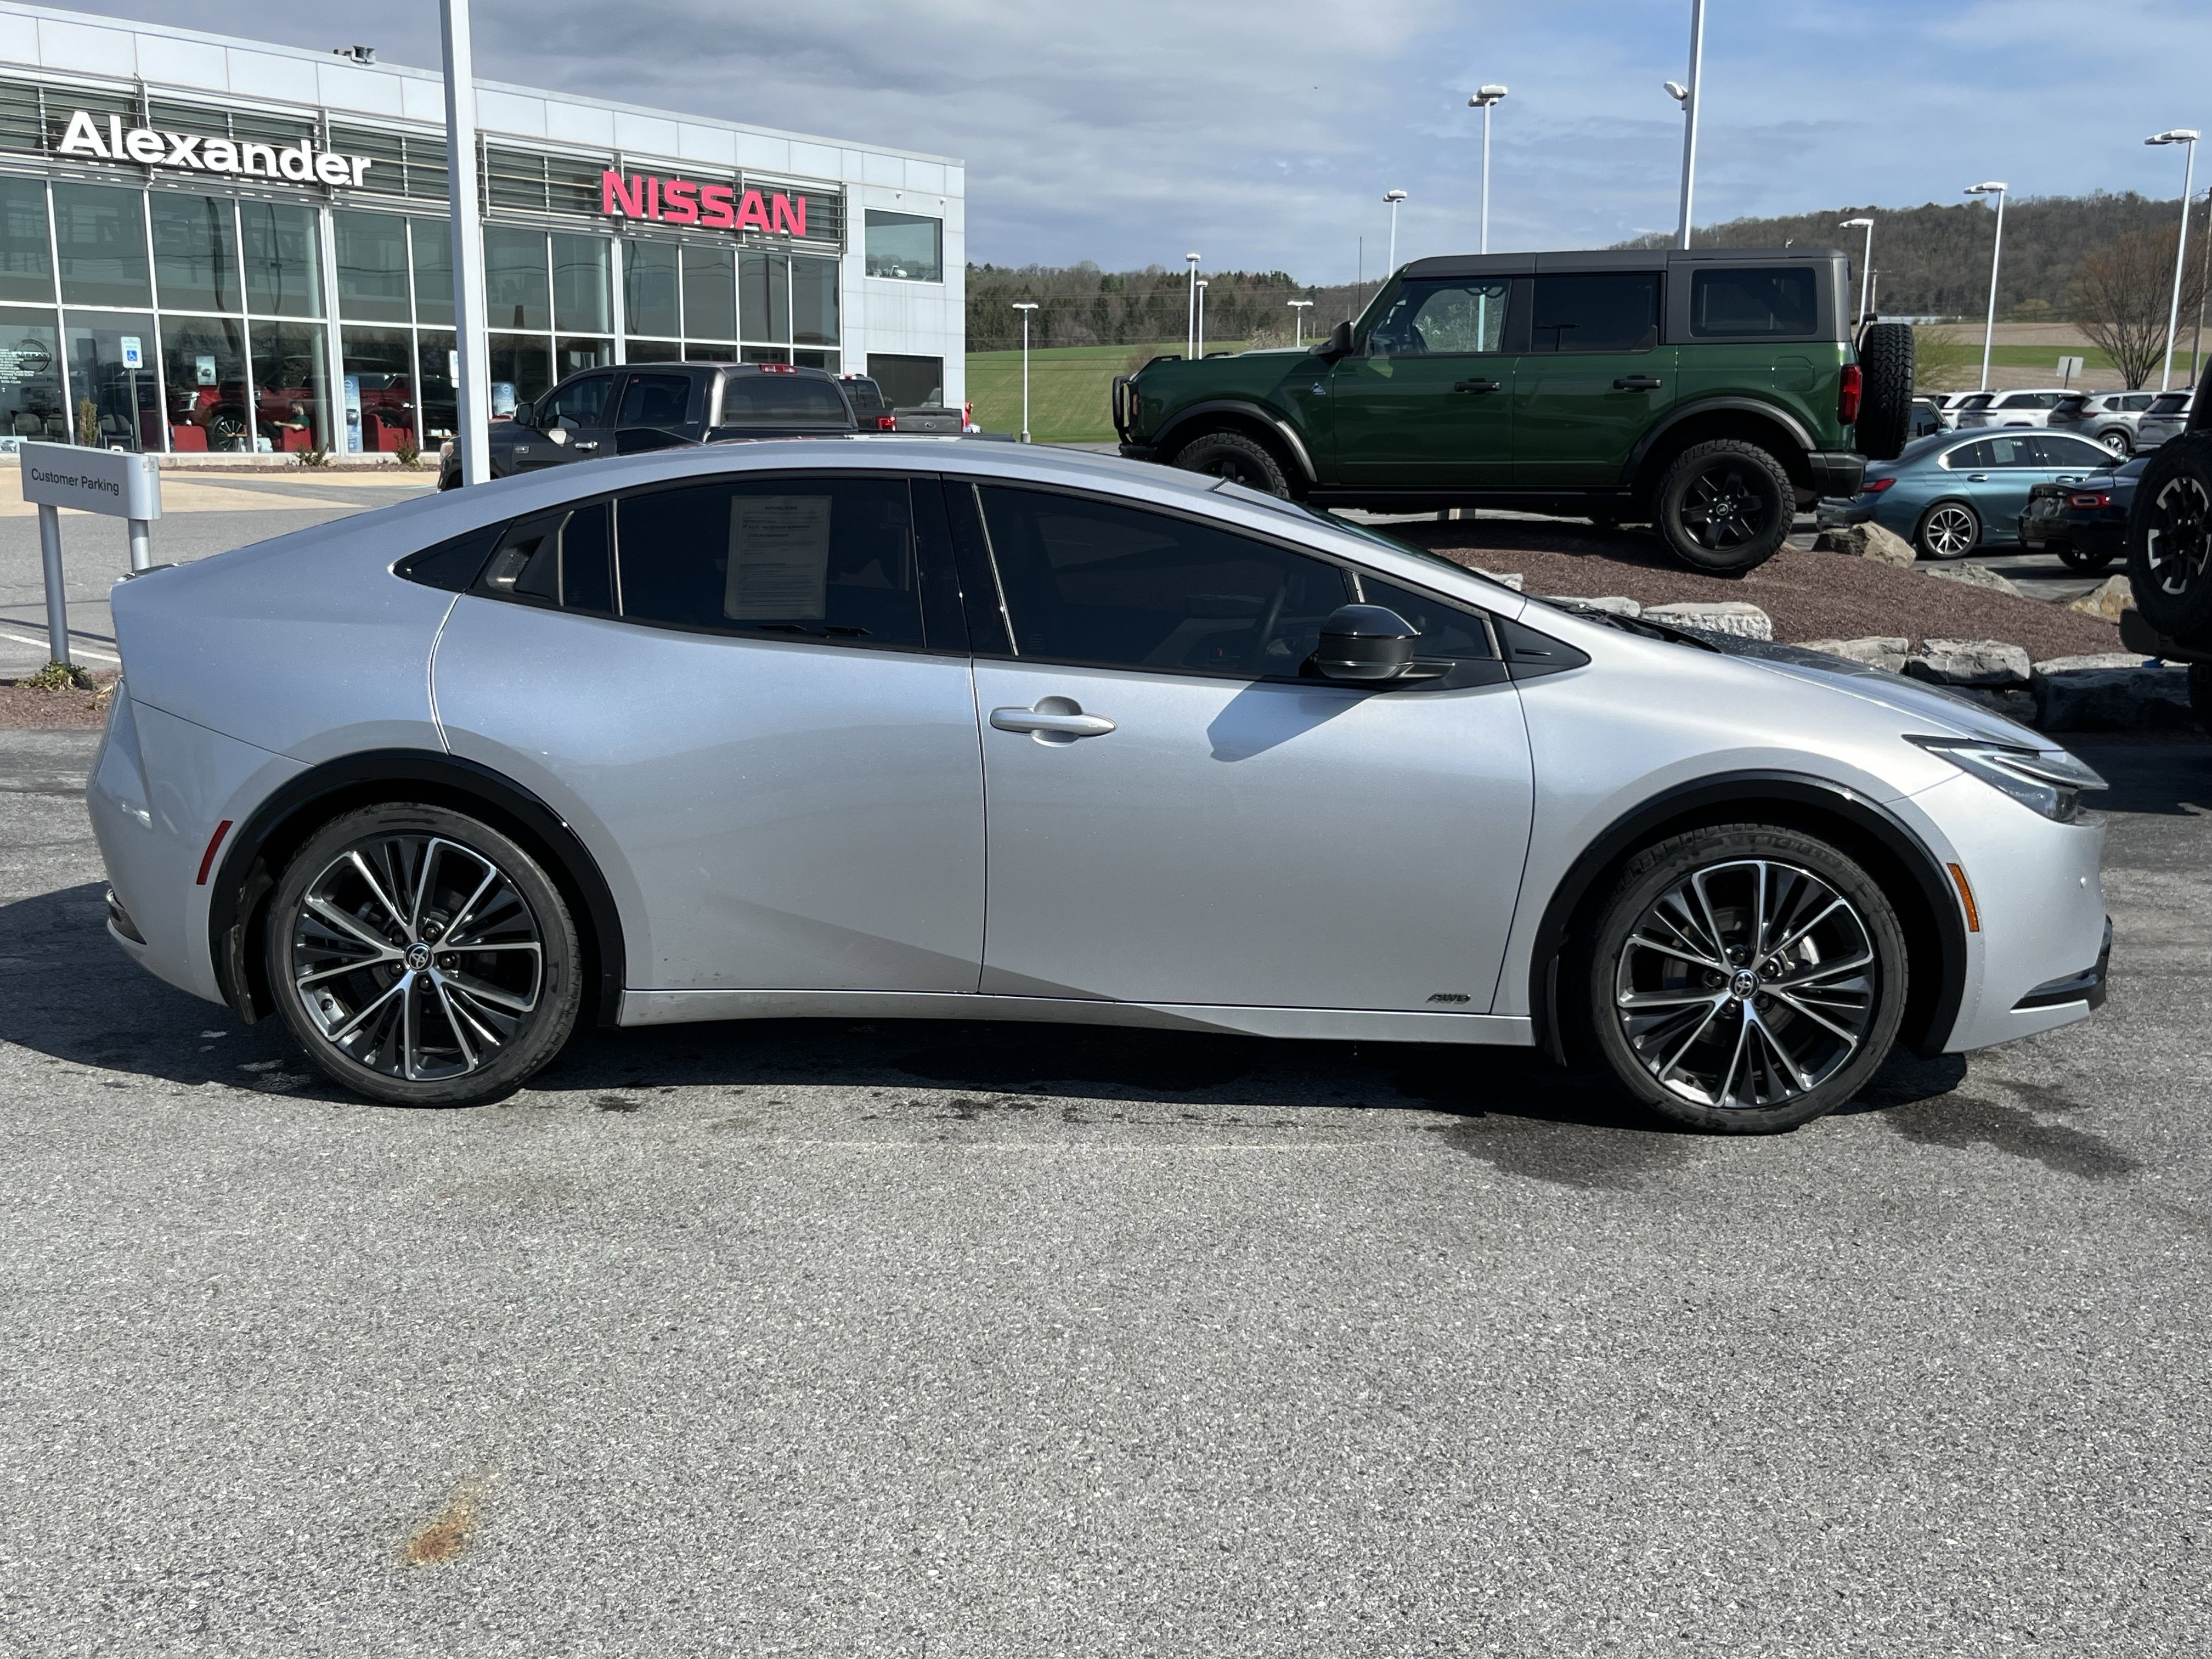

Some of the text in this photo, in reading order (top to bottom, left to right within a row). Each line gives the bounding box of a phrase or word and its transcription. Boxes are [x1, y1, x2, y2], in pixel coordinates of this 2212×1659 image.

[60, 111, 371, 187] Alexander
[603, 171, 806, 236] NISSAN
[31, 468, 120, 496] Customer Parking
[1426, 992, 1471, 1003] AWD
